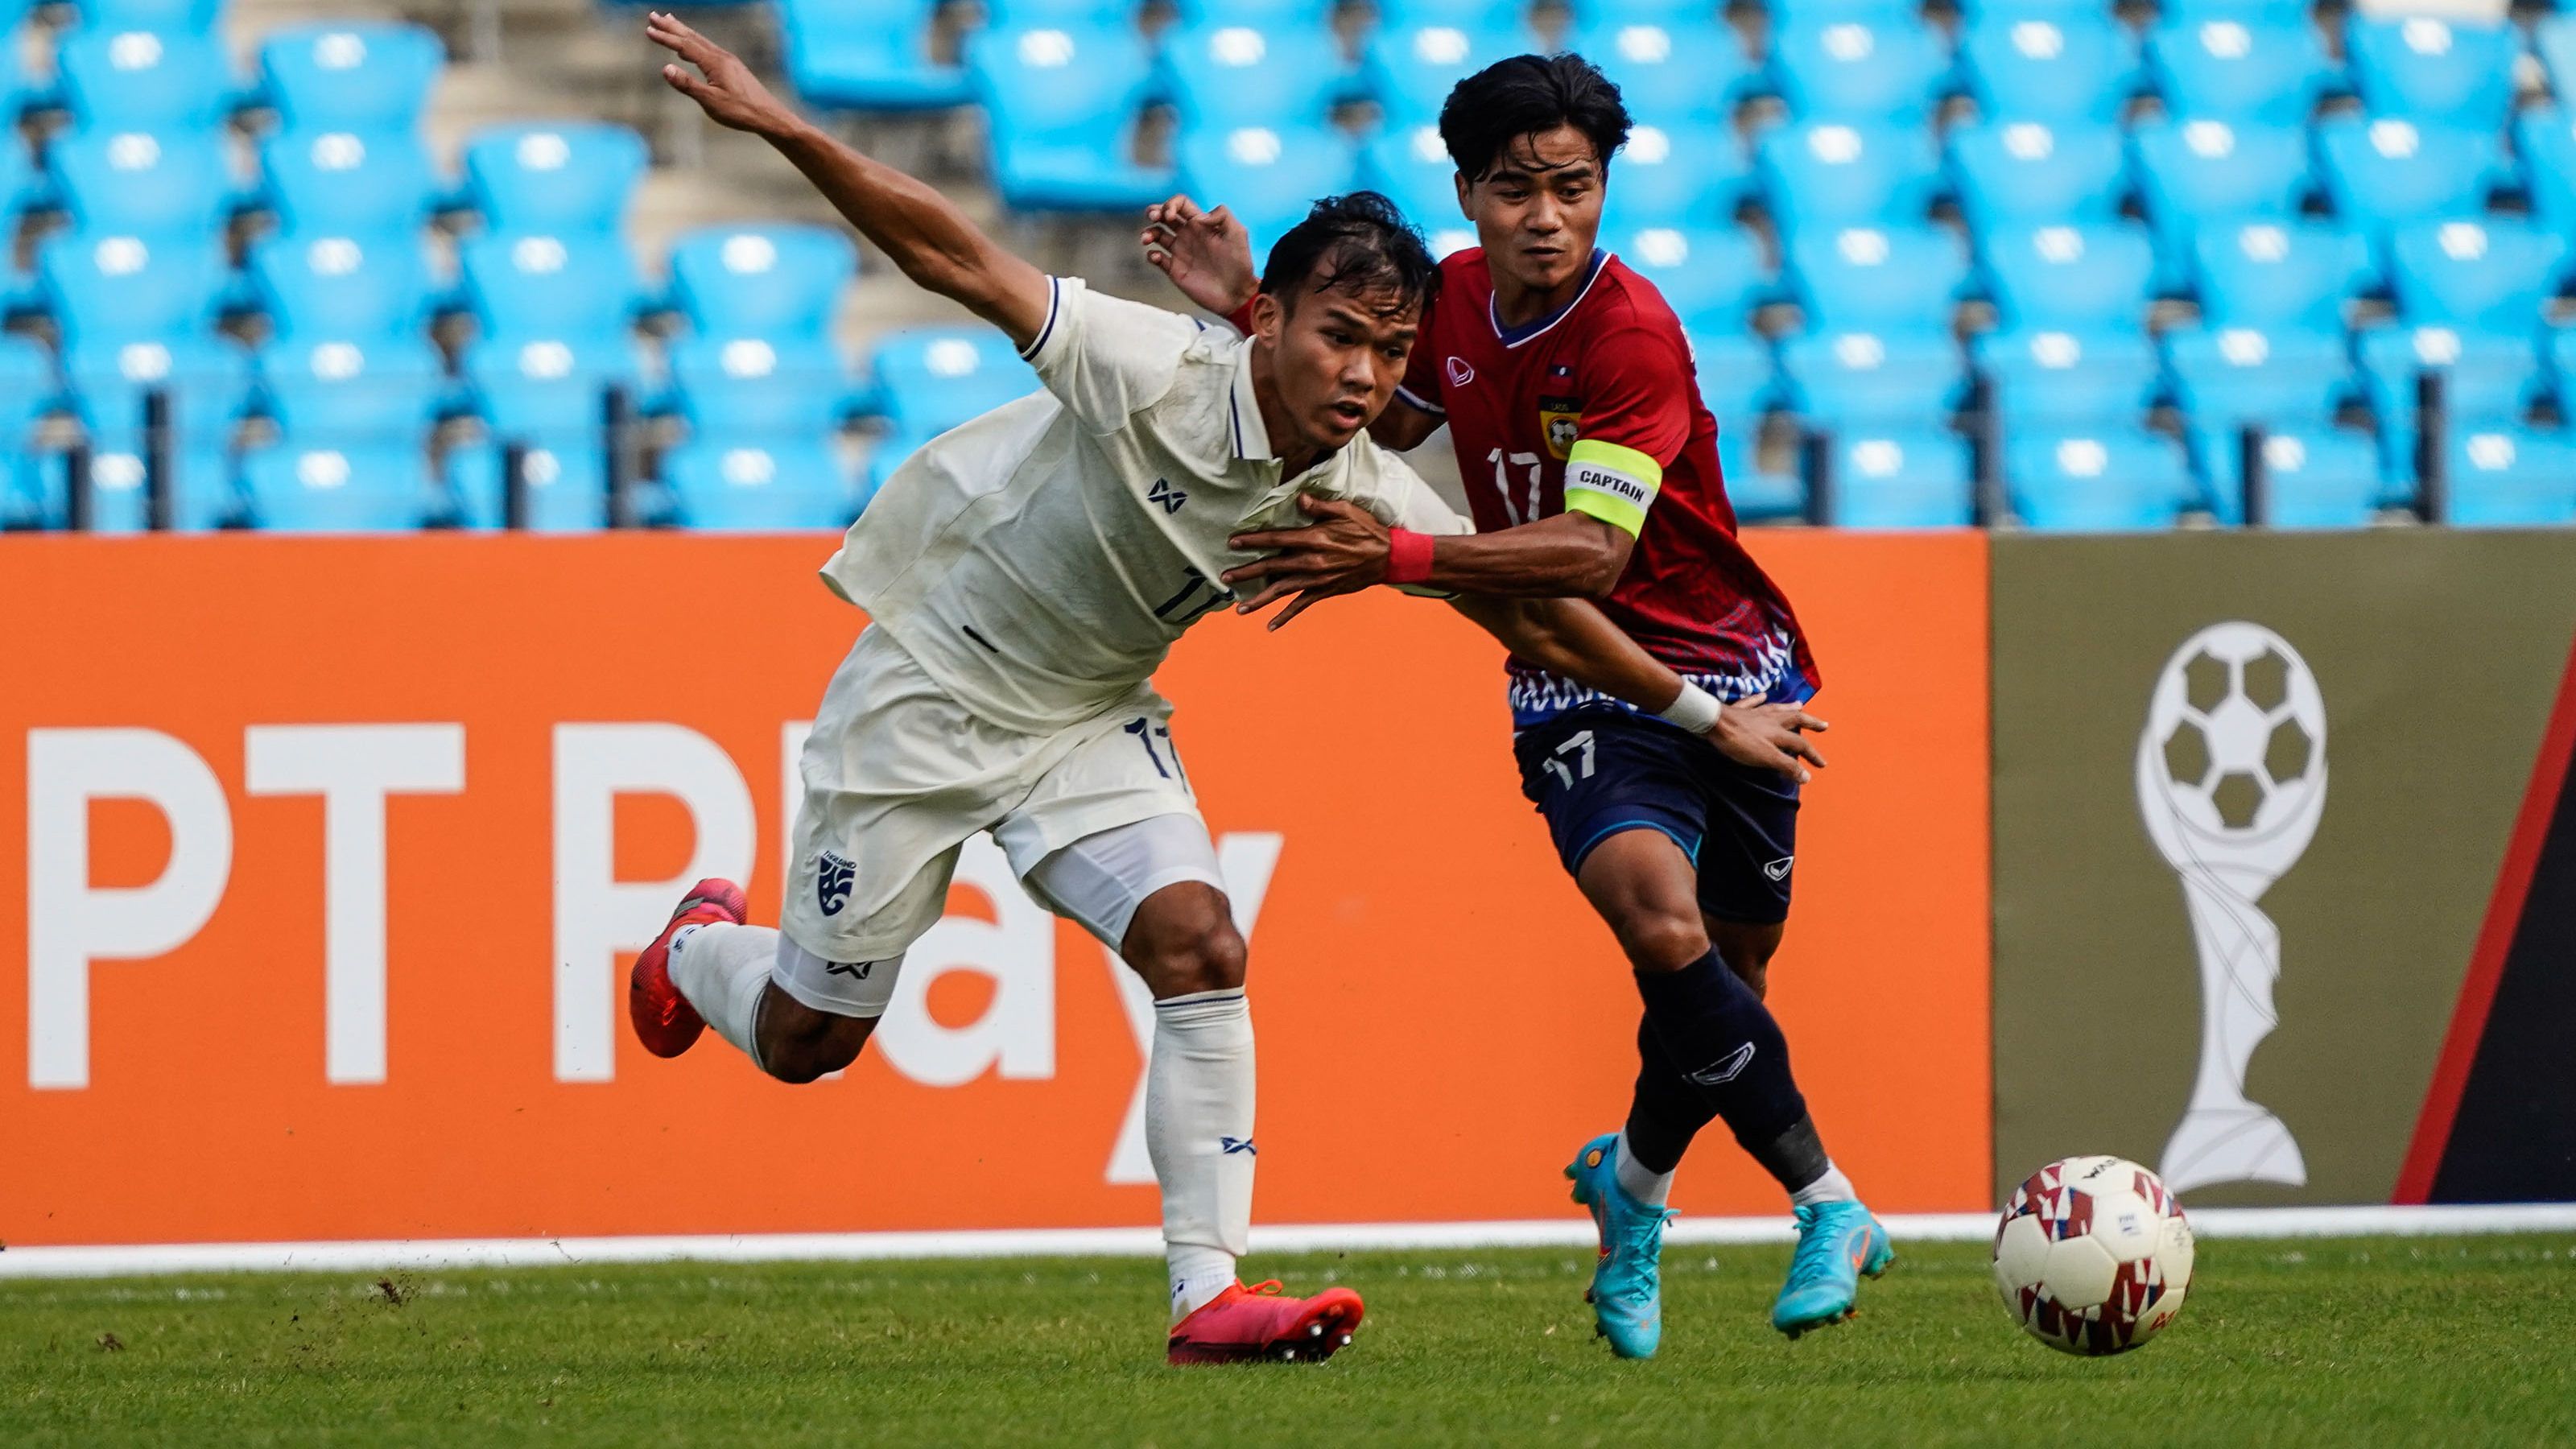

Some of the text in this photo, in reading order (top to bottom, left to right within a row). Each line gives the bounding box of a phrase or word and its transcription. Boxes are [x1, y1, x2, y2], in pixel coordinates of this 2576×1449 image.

[1487, 448, 1542, 527] 17
[1579, 470, 1645, 502] CAPTAIN
[1542, 729, 1596, 791] 17
[27, 721, 1284, 1184] PT Pa
